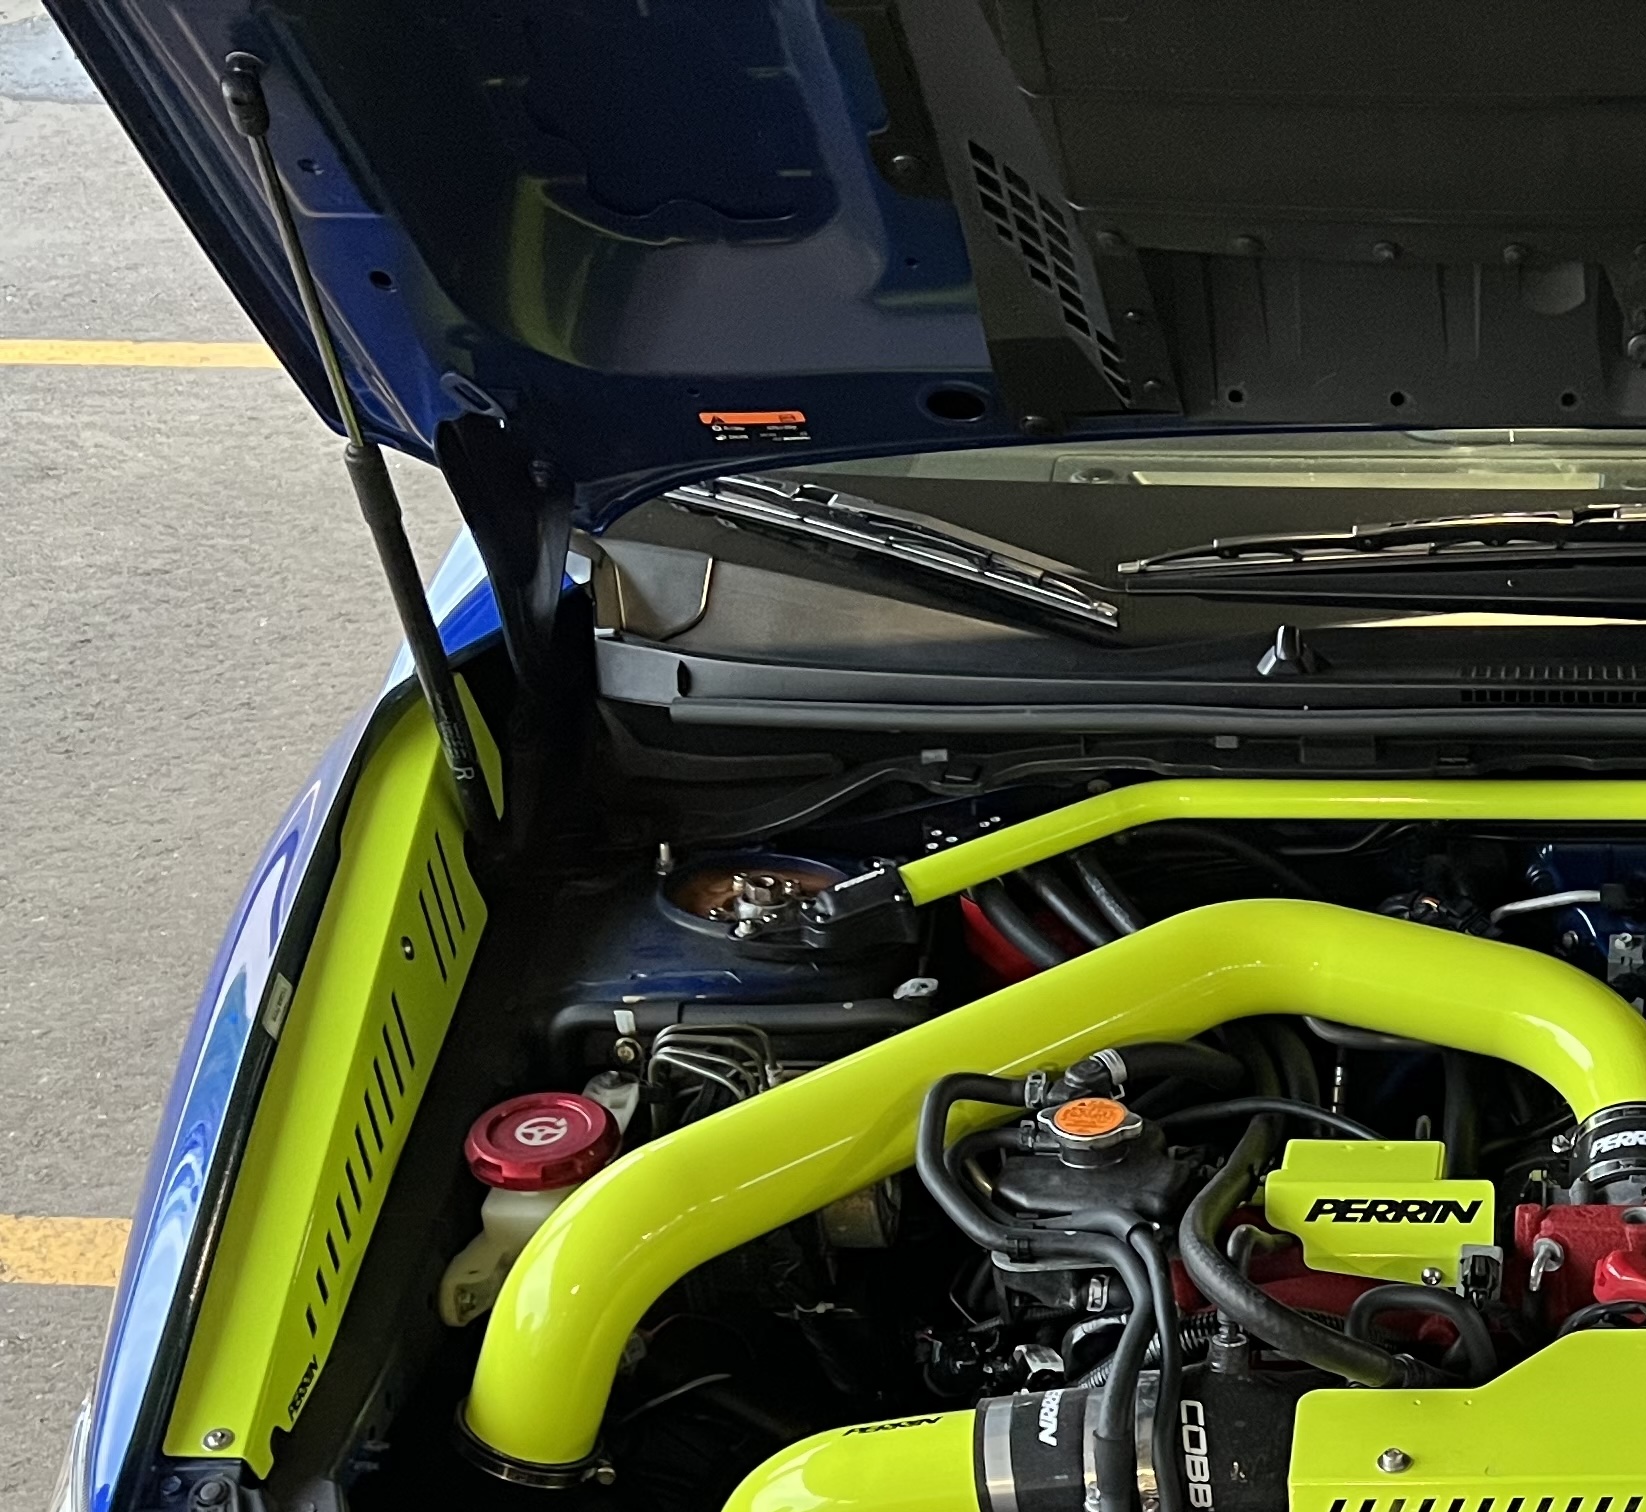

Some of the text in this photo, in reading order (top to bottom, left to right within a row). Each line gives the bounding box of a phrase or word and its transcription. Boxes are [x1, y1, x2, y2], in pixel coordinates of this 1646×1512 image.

[1304, 1199, 1484, 1223] PERRIN
[287, 1354, 318, 1422] PERRIN
[1180, 1400, 1214, 1508] COBB
